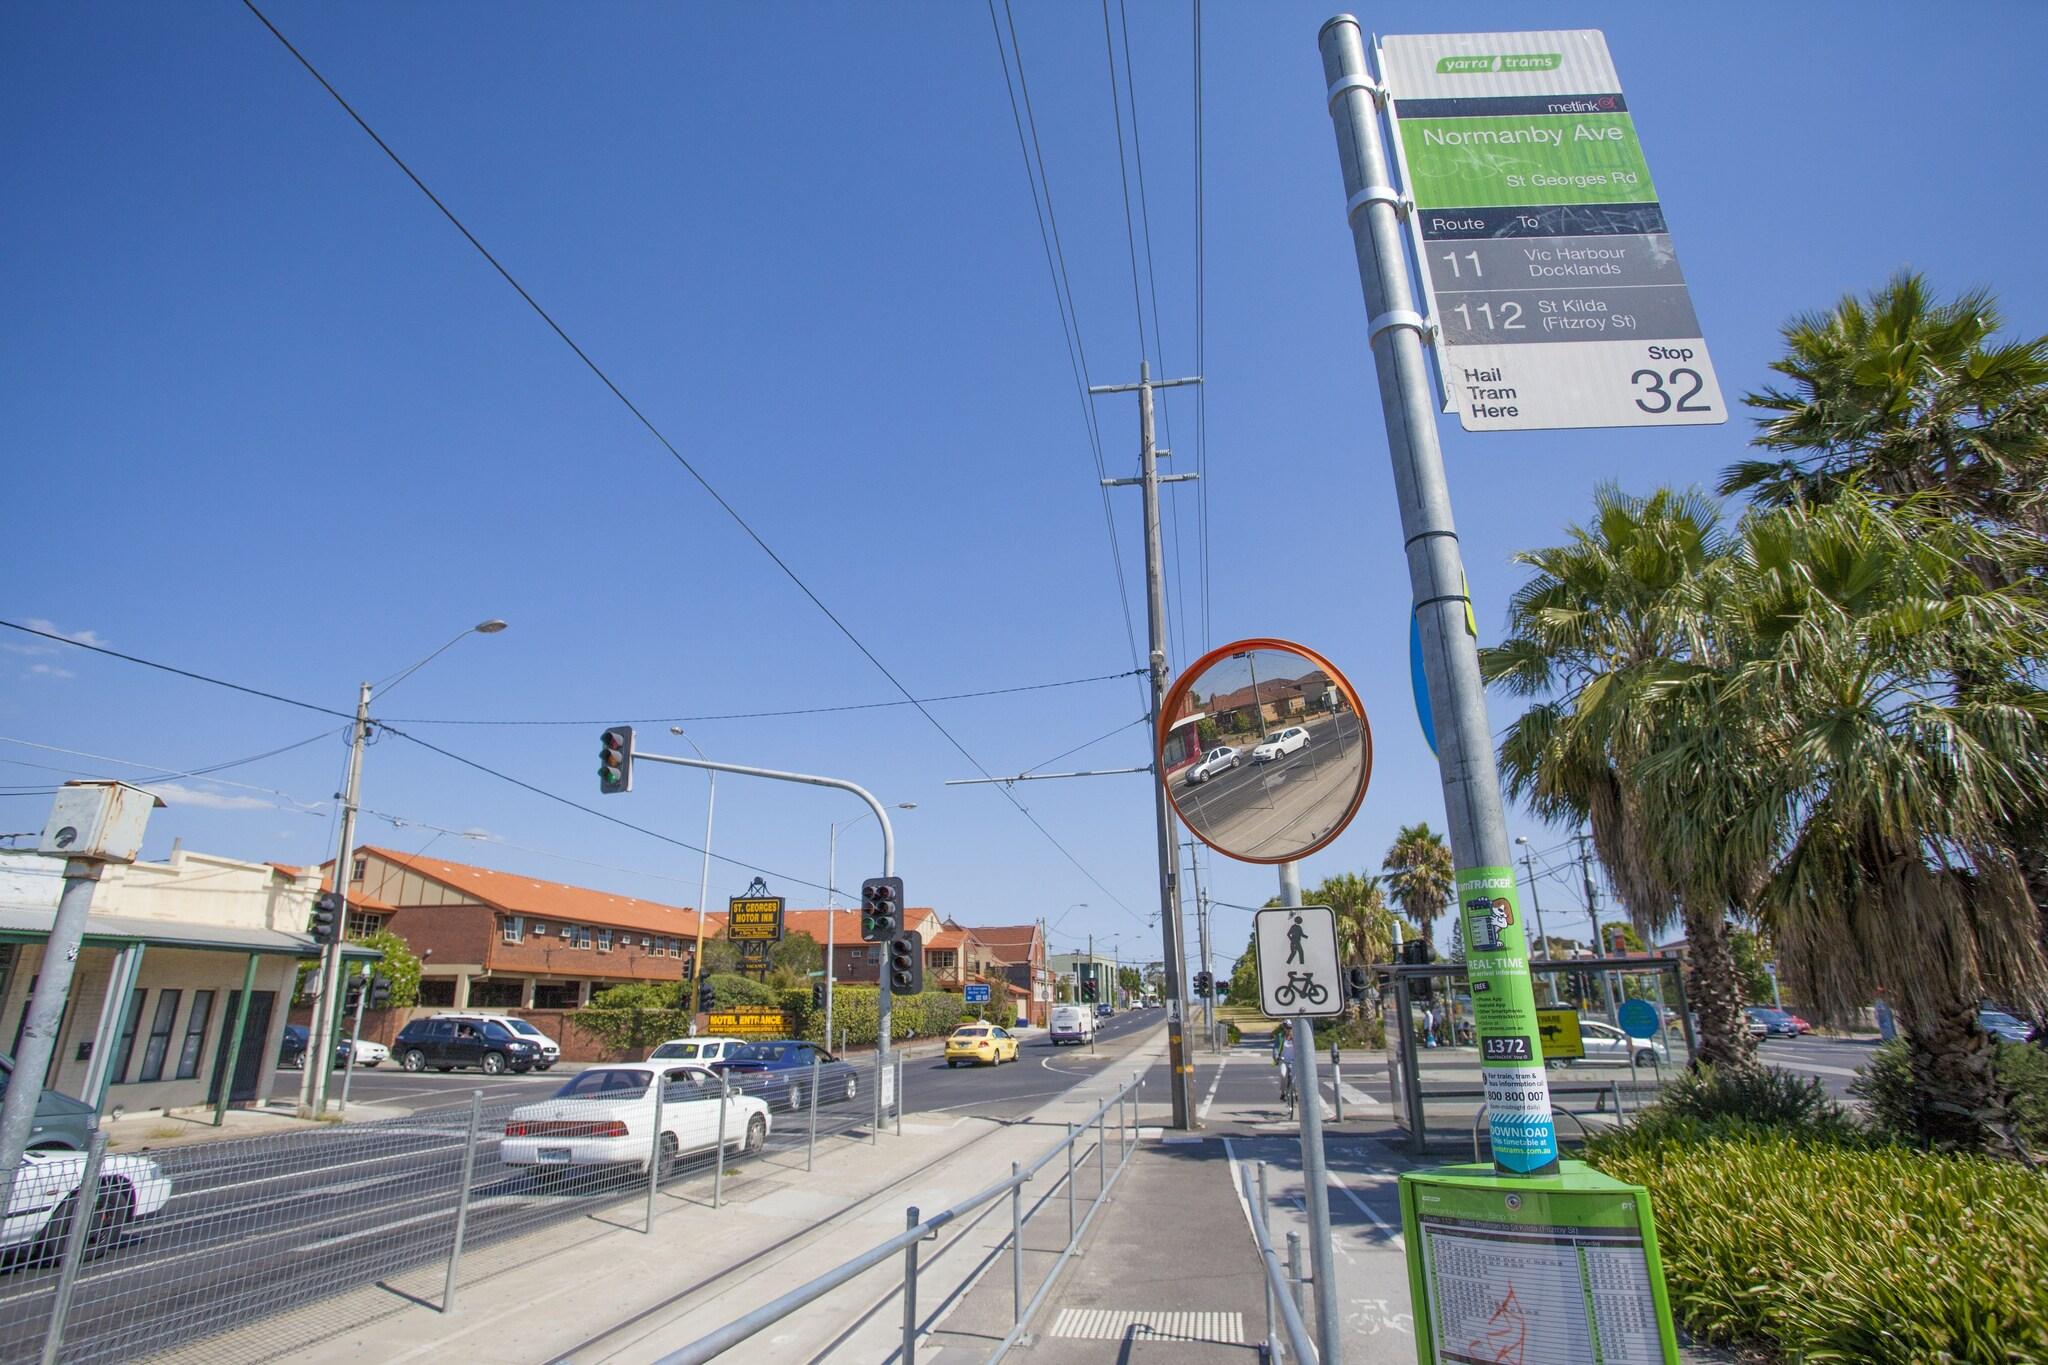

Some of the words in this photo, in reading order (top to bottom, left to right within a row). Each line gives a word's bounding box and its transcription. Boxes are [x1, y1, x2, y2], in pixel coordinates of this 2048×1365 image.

[1445, 58, 1488, 71] yarra
[1505, 55, 1553, 68] trams
[1548, 100, 1599, 113] metlink
[1423, 124, 1565, 148] Normanby
[1573, 123, 1625, 142] Ave
[1506, 174, 1527, 188] St
[1531, 173, 1608, 189] Georges
[1611, 171, 1638, 185] Rd
[1432, 217, 1485, 232] Route
[1516, 215, 1539, 229] To
[1442, 250, 1483, 278] 11
[1524, 248, 1552, 261] Vic
[1557, 246, 1626, 260] Harbour
[1529, 262, 1622, 278] Docklands
[1454, 301, 1526, 330] 112
[1537, 300, 1560, 313] St
[1562, 299, 1608, 312] Kilda
[1542, 315, 1607, 332] (Fitzroy
[1611, 313, 1637, 329] St)
[1647, 345, 1694, 363] Stop
[1464, 368, 1502, 384] Hail
[1631, 367, 1712, 414] 32
[1466, 385, 1517, 400] Tram
[1471, 402, 1519, 418] Here
[733, 903, 744, 913] ST.
[746, 902, 777, 913] GEORGES
[736, 913, 760, 923] MOTOR
[761, 912, 774, 923] INN
[1469, 958, 1525, 970] REAL-TIME
[1474, 982, 1487, 991] FREE
[710, 1015, 738, 1025] MOTEL
[740, 1015, 782, 1025] ENTRANCE
[1487, 1039, 1526, 1053] 1372
[1497, 1072, 1514, 1080] train,
[1505, 1092, 1525, 1101] 800
[1527, 1091, 1544, 1101] 007
[1490, 1127, 1548, 1138] DOWNLOAD
[1503, 1138, 1539, 1146] timetable
